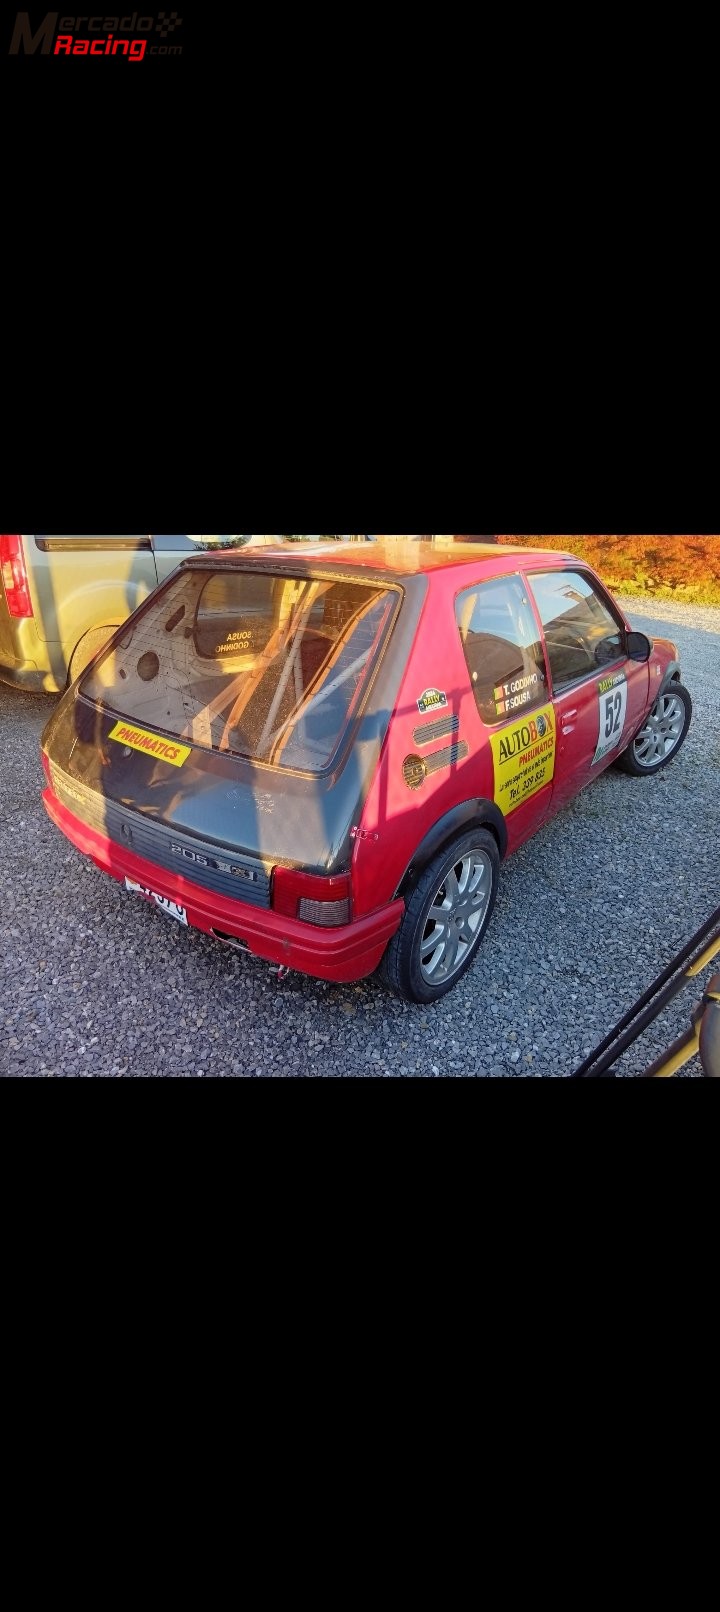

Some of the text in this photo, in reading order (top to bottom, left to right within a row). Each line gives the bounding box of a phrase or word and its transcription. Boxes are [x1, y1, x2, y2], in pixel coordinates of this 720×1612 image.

[499, 712, 553, 762] AUTOBOX
[604, 691, 622, 738] 52
[171, 843, 209, 867] 205
